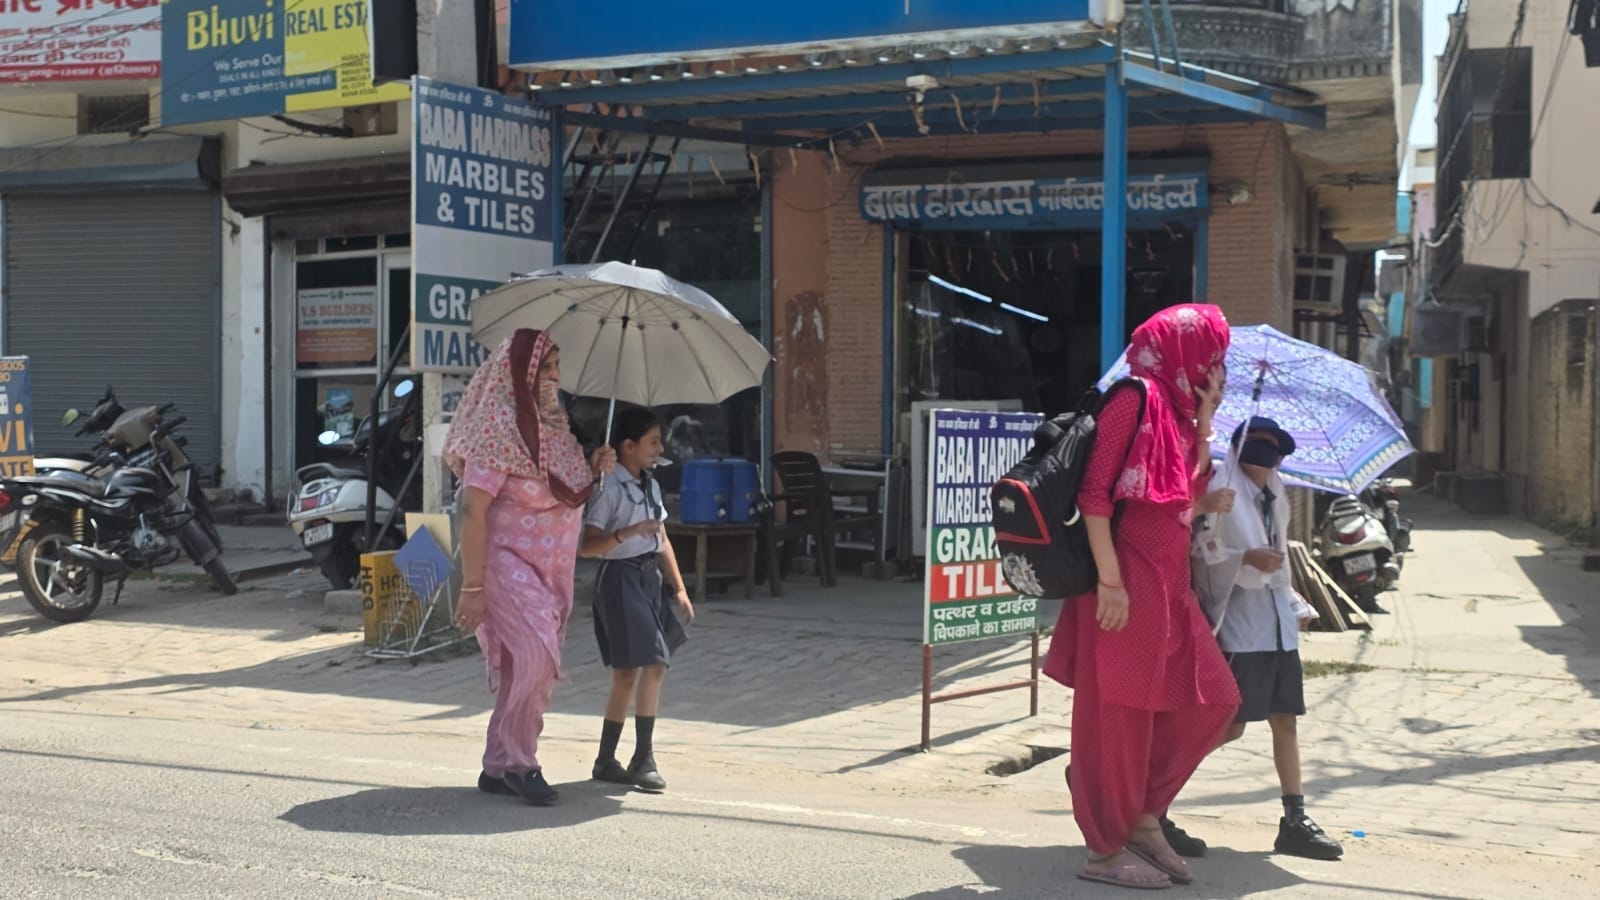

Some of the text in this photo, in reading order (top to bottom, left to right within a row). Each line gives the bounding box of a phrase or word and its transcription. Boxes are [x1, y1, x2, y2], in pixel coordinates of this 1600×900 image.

[186, 0, 273, 50] Bhuvi
[285, 8, 328, 37] REAL
[213, 53, 283, 71] We Serve Our
[419, 102, 551, 168] BABA HARIDASS
[424, 152, 546, 201] MARBLES
[436, 191, 536, 234] & TILES
[862, 185, 922, 220] बाबा
[924, 175, 1035, 218] हरिदास
[320, 302, 374, 318] BUILDERS
[428, 284, 494, 321] GRA
[0, 402, 26, 453] vi
[936, 436, 975, 484] BABA
[936, 487, 994, 524] MARBLES
[936, 527, 1002, 563] GRAN
[942, 562, 1013, 599] TILE
[933, 595, 1039, 621] पत्थर व टाईल
[933, 616, 1036, 641] चिपकाने का सामान
